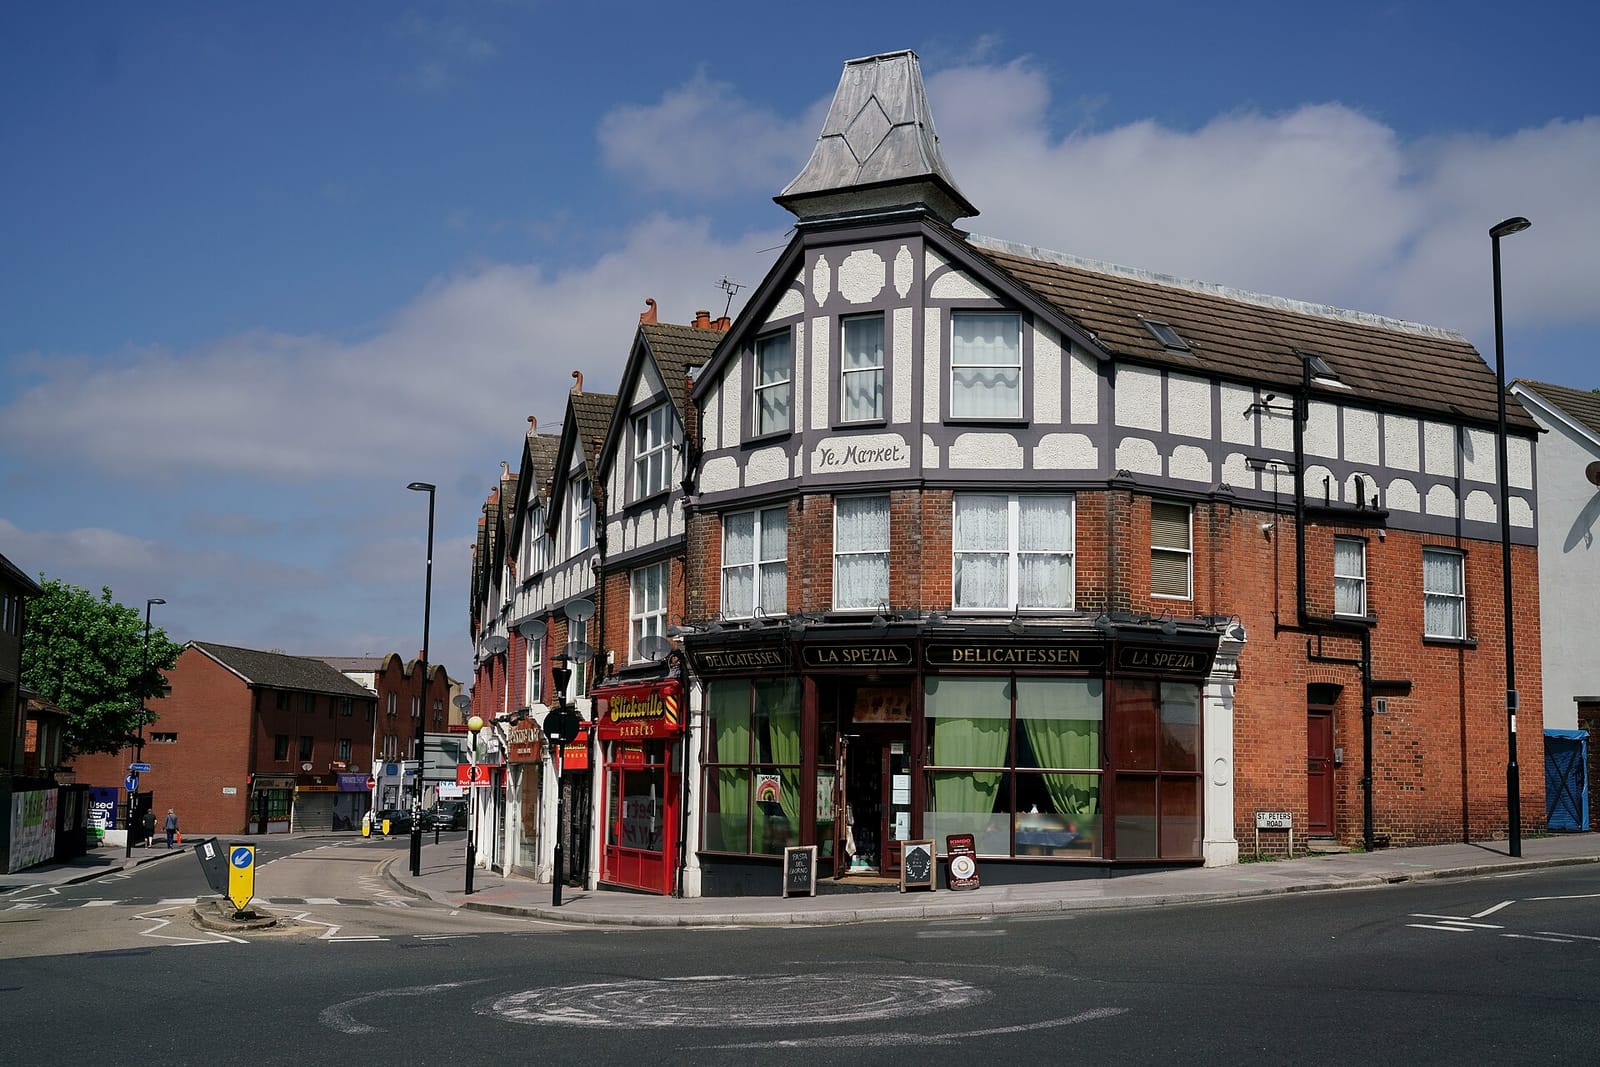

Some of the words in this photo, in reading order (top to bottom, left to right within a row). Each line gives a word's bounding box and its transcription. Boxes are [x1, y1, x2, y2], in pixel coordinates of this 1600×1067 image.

[841, 445, 905, 465] Market.
[705, 651, 782, 668] DELICATESSEN
[818, 650, 839, 662] LA
[843, 649, 898, 662] SPEZIA
[952, 648, 1080, 663] DELICATESSEN
[1132, 651, 1149, 665] LA
[1152, 653, 1195, 668] SPEZIA
[610, 693, 662, 722] Slicksville
[89, 801, 114, 809] Used
